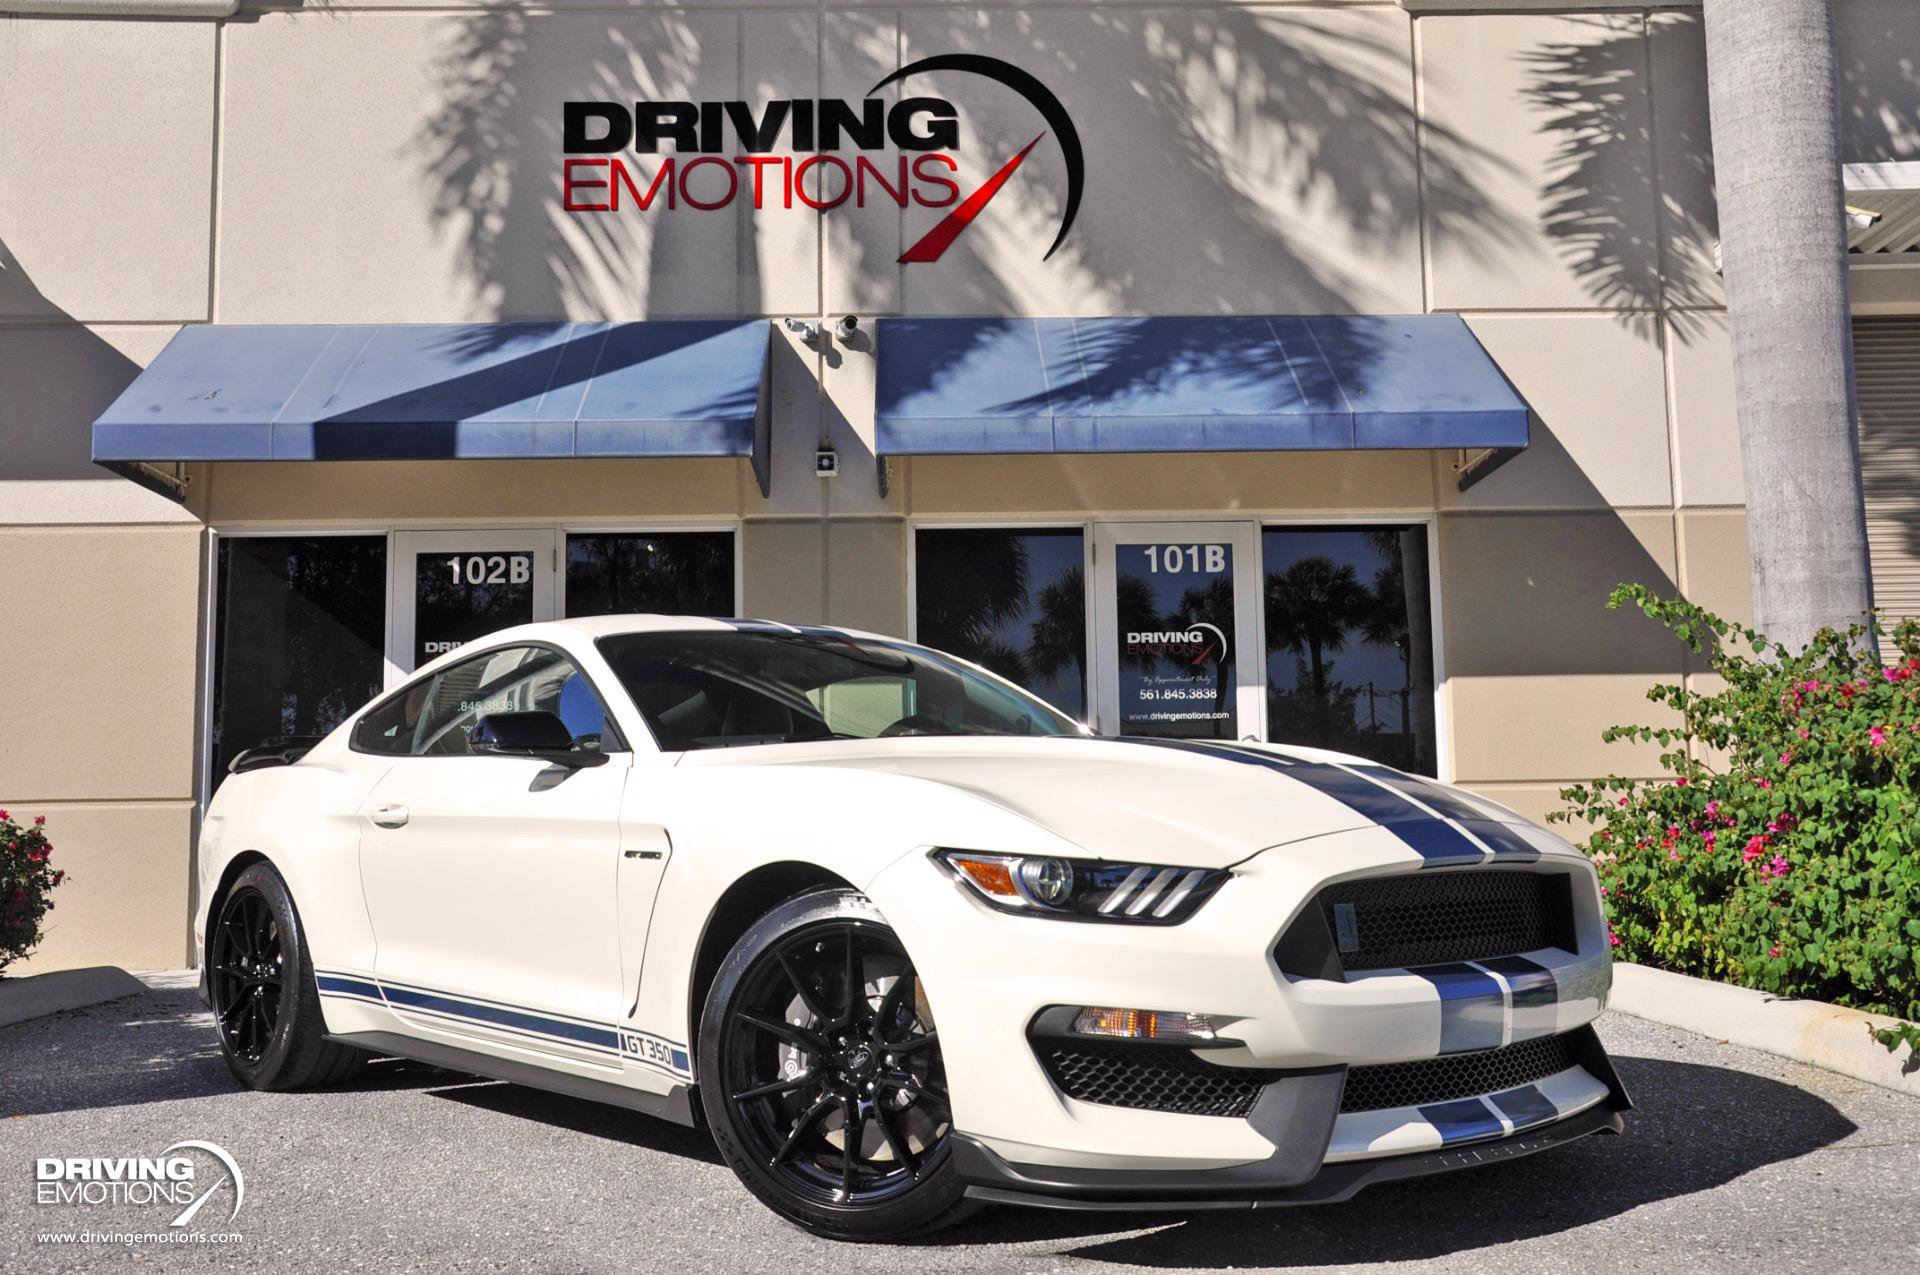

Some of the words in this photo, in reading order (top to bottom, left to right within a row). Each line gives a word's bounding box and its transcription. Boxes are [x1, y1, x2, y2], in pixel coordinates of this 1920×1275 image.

[563, 98, 958, 154] DRIVING
[563, 154, 960, 212] EMOTIONS
[1144, 545, 1225, 573] 101B
[447, 556, 530, 584] 102B
[1127, 631, 1203, 644] DRIVING
[1127, 643, 1203, 656] EMOTIONS
[1139, 688, 1217, 700] 561.845.3838
[1129, 711, 1229, 722] www.drivingemotions.com
